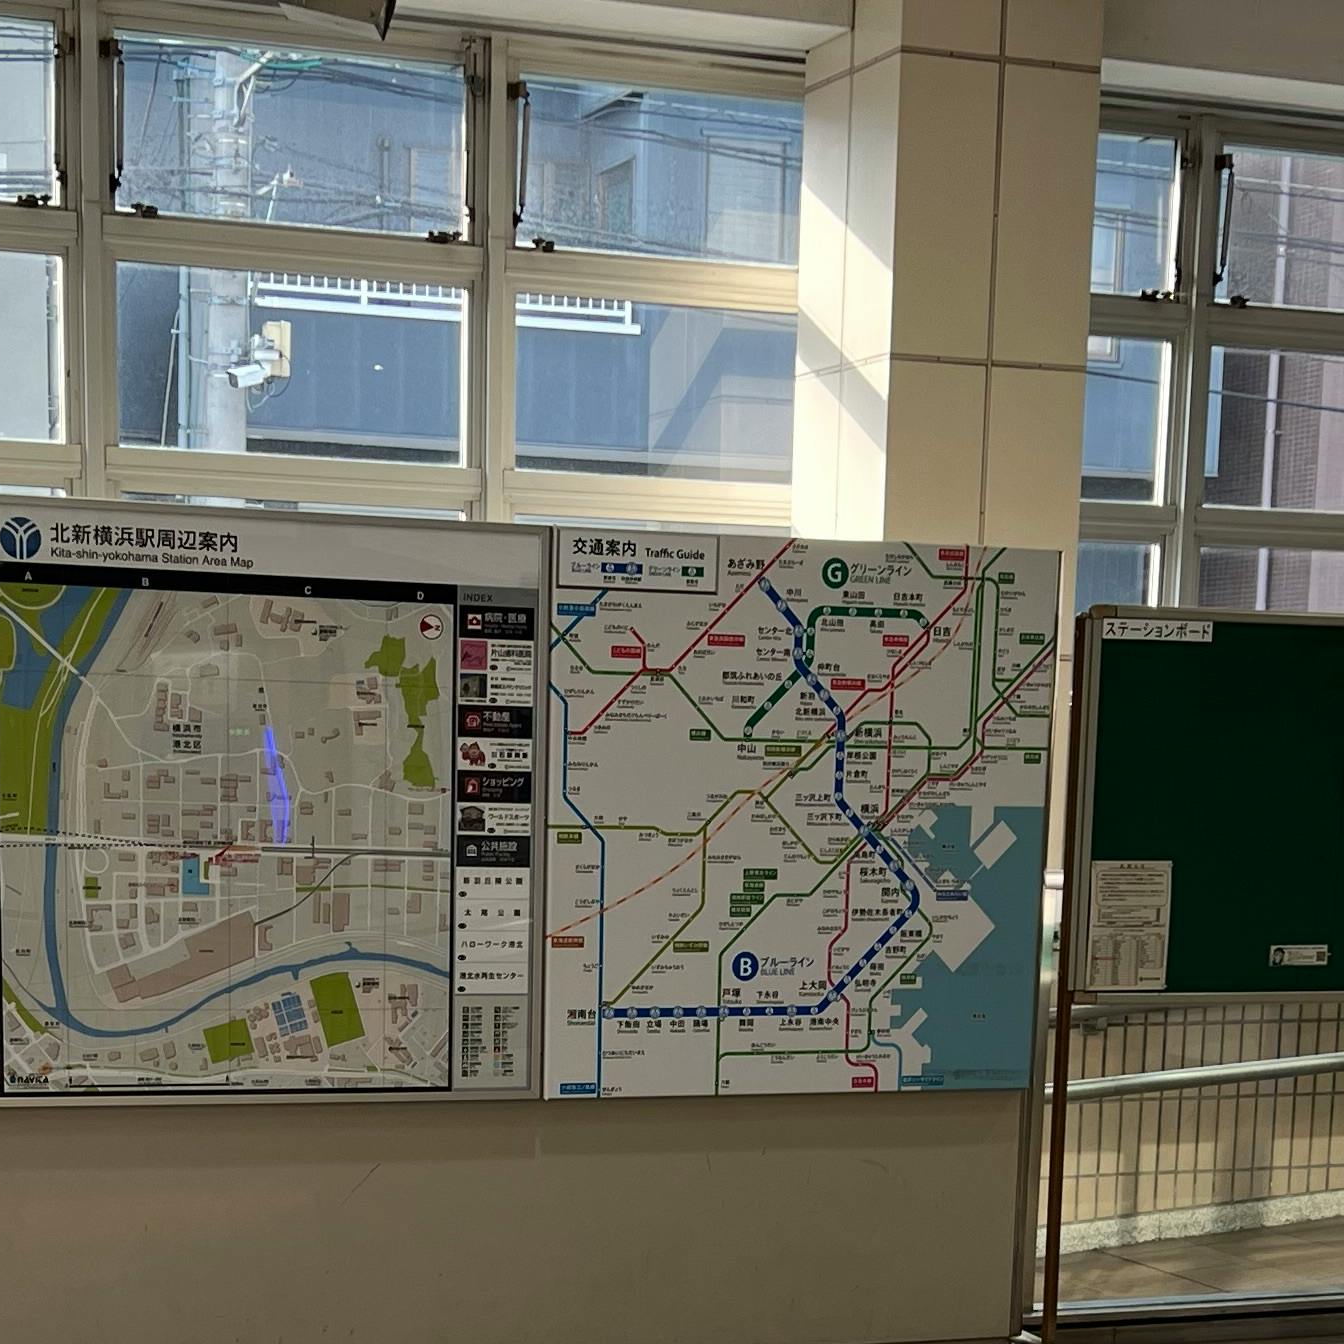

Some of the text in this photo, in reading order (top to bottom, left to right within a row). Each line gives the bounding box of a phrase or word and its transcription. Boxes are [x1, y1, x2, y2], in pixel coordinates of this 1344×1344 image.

[50, 522, 238, 553] 北新横浜駅周辺案内
[572, 537, 636, 557] 交通案内
[50, 547, 254, 570] Kita-shin-yokohama Station Area Map
[646, 548, 705, 560] Traffic Guide
[728, 558, 766, 570] あざみ野
[827, 563, 842, 582] G
[850, 563, 912, 576] グリーンライン
[24, 571, 33, 581] A
[142, 578, 150, 587] B
[304, 586, 312, 595] C
[416, 591, 424, 600] D
[463, 593, 493, 602] INDEX
[758, 626, 793, 636] センター北
[933, 626, 952, 637] 日吉
[1105, 621, 1212, 641] ステーションボード
[756, 647, 791, 656] センター南
[482, 712, 510, 722] 不動産
[795, 708, 826, 716] 北新横浜
[172, 724, 202, 734] 横浜市
[854, 727, 882, 738] 新横浜
[737, 743, 757, 754] 中山
[482, 777, 524, 788] ショッピング
[860, 804, 880, 814] 横浜
[881, 887, 900, 897] 関内
[461, 940, 524, 948] ハローワーク港北
[739, 957, 753, 976] B
[761, 956, 815, 968] ブルーライン
[799, 980, 827, 990] 上大岡
[722, 988, 741, 998] 戸塚
[567, 1009, 596, 1020] 湘南台
